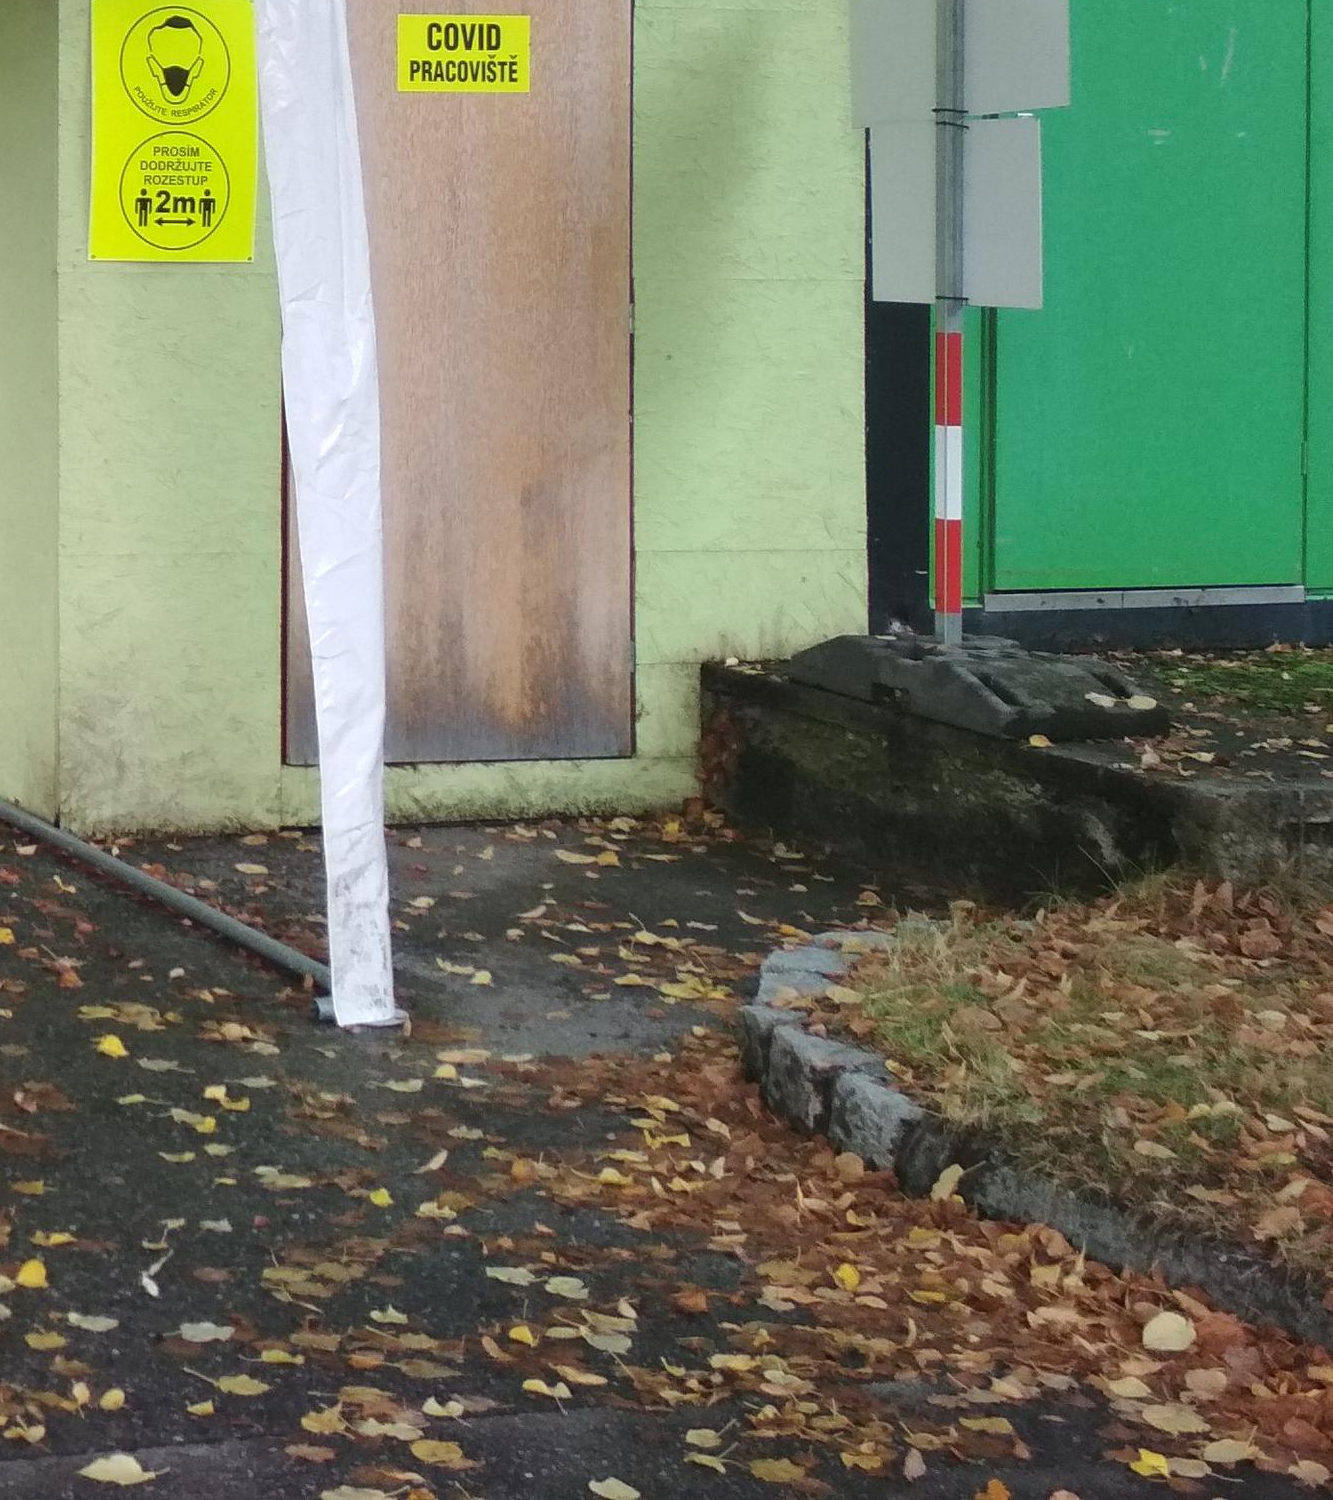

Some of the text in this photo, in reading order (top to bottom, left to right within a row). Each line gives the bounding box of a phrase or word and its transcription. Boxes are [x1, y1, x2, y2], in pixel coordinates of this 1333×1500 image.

[427, 22, 501, 51] COVID
[409, 54, 518, 83] PRACOVIŠTĚ
[153, 145, 200, 157] PROSÍM
[140, 158, 213, 172] DODRŽUJTE
[144, 174, 208, 186] ROZESTUP
[155, 190, 195, 213] 2m
